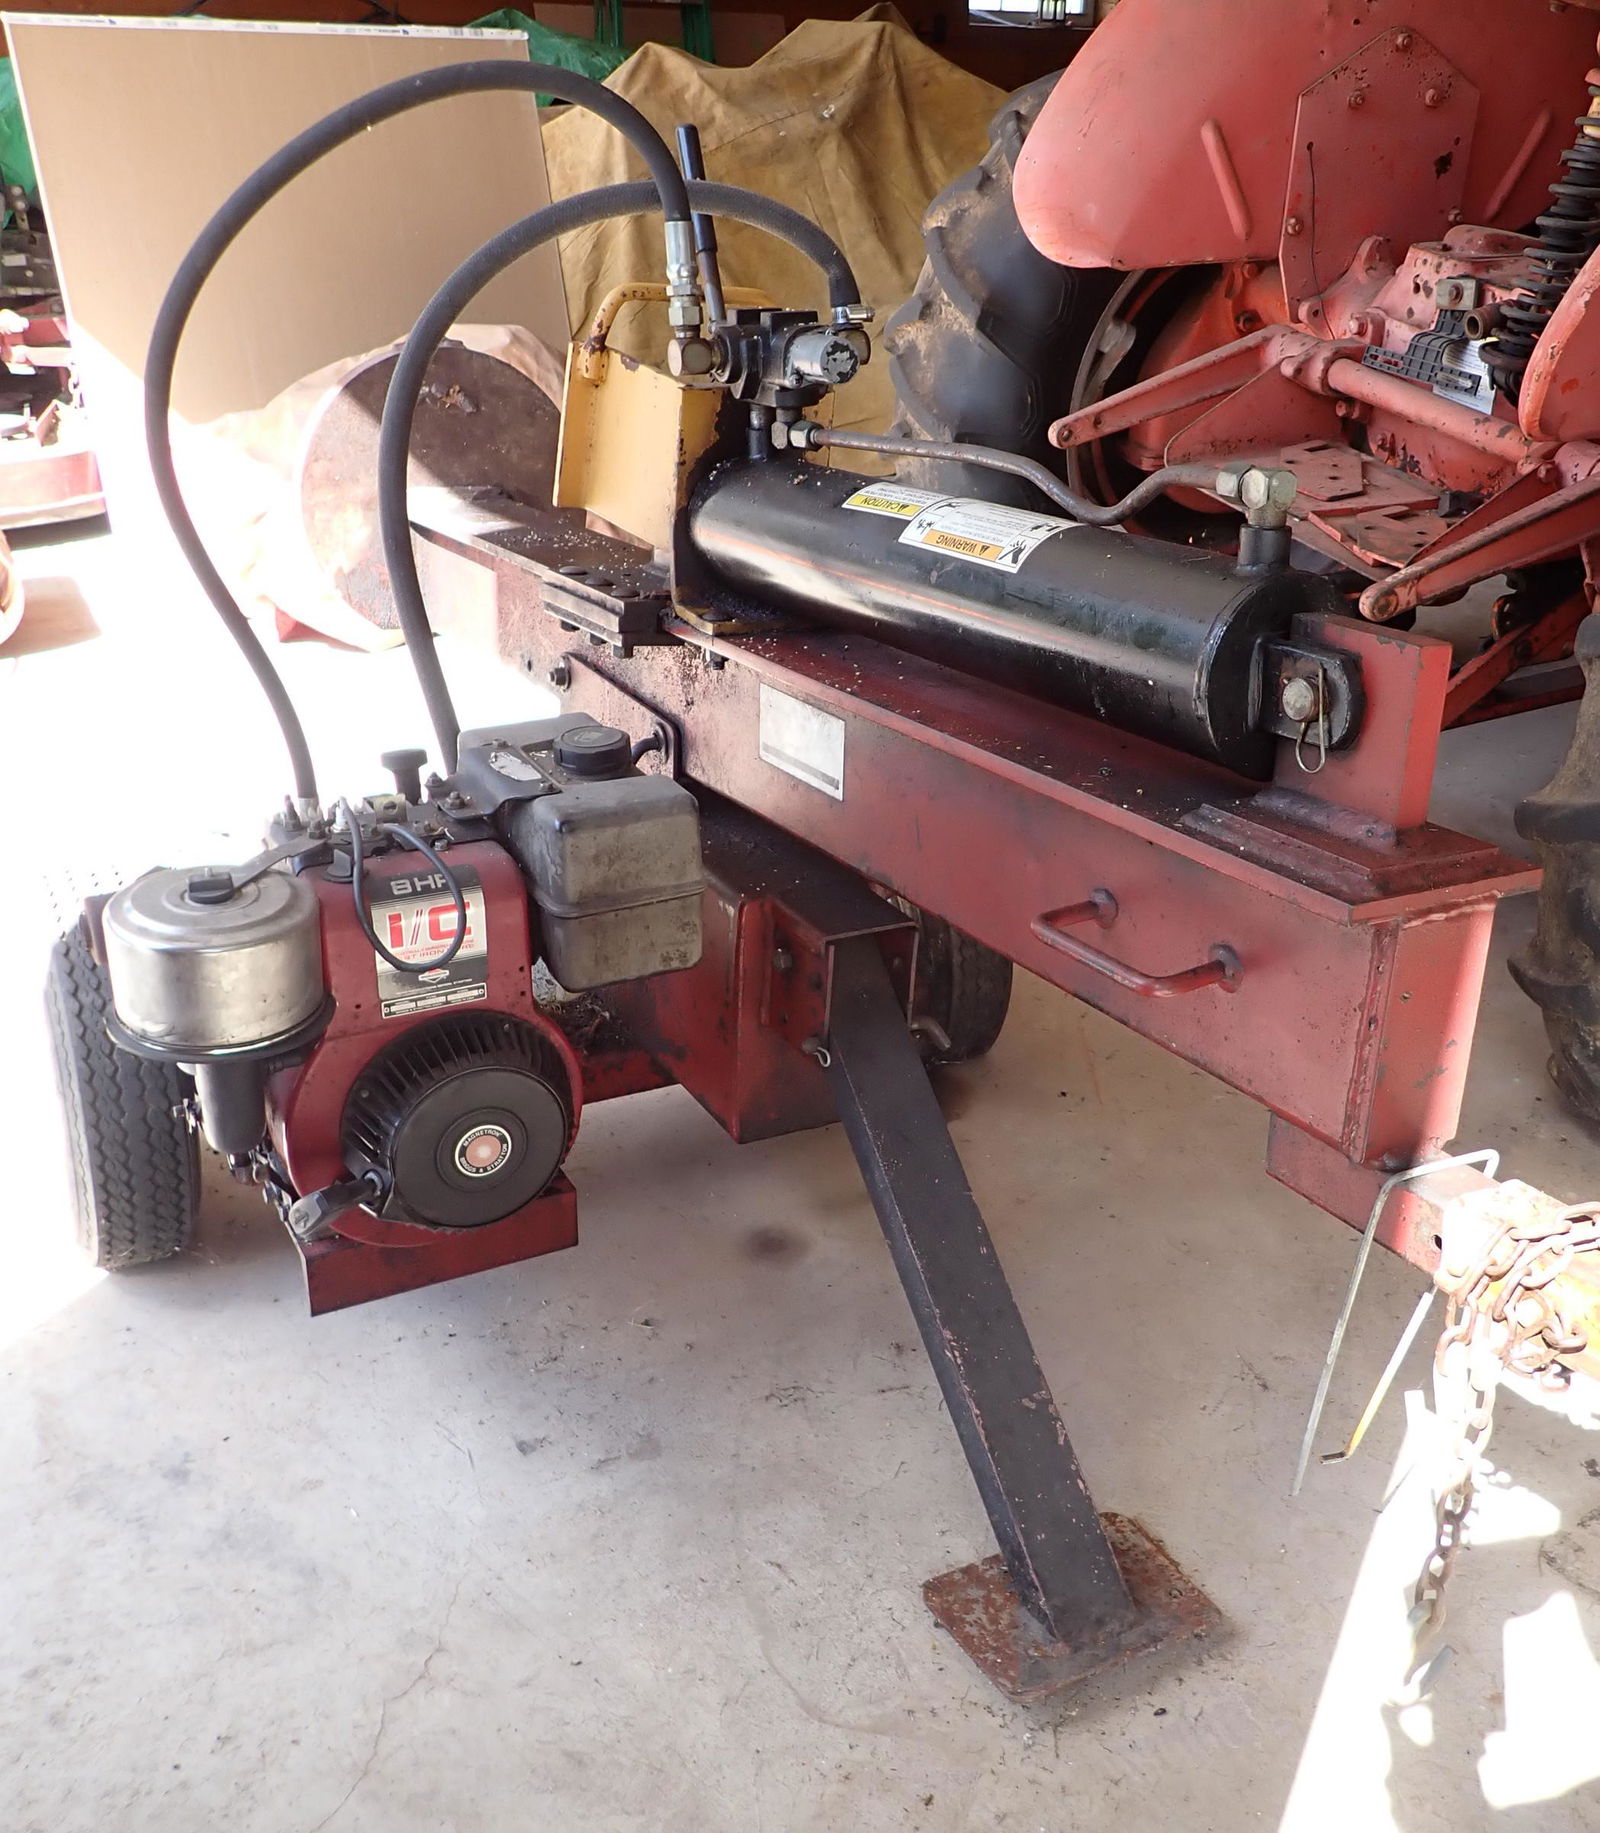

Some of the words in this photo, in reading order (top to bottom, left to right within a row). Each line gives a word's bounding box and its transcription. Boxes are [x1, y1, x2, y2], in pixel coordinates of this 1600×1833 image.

[860, 496, 897, 510] CAUTION
[935, 534, 977, 553] WARNING
[462, 1129, 501, 1147] MAGNETRON
[486, 1143, 508, 1171] STRATTON
